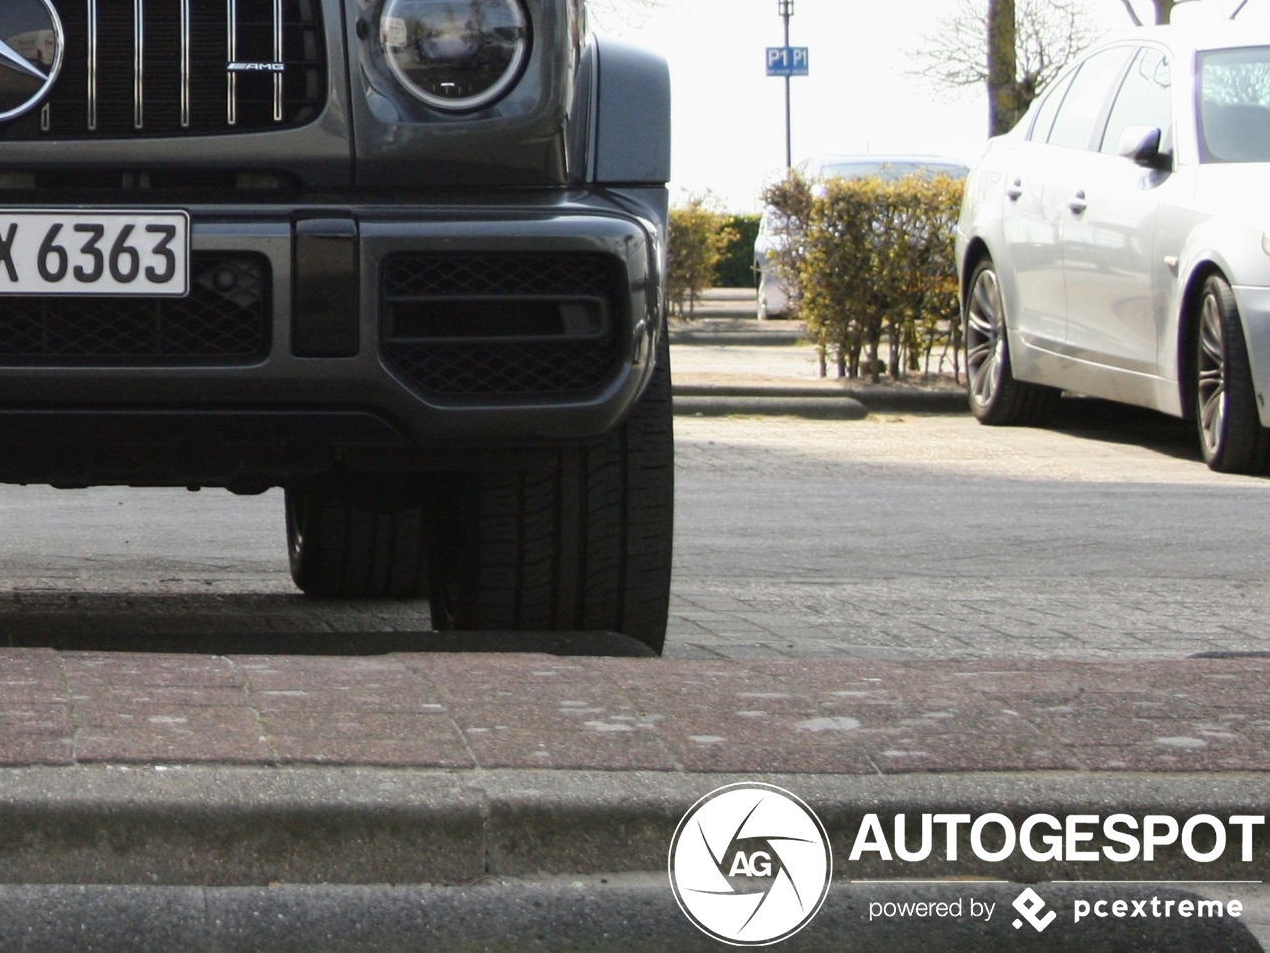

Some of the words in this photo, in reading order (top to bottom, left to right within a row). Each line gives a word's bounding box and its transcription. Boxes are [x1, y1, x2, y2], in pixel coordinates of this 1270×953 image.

[768, 49, 787, 67] P1
[793, 49, 807, 67] P1
[37, 223, 177, 284] 6363
